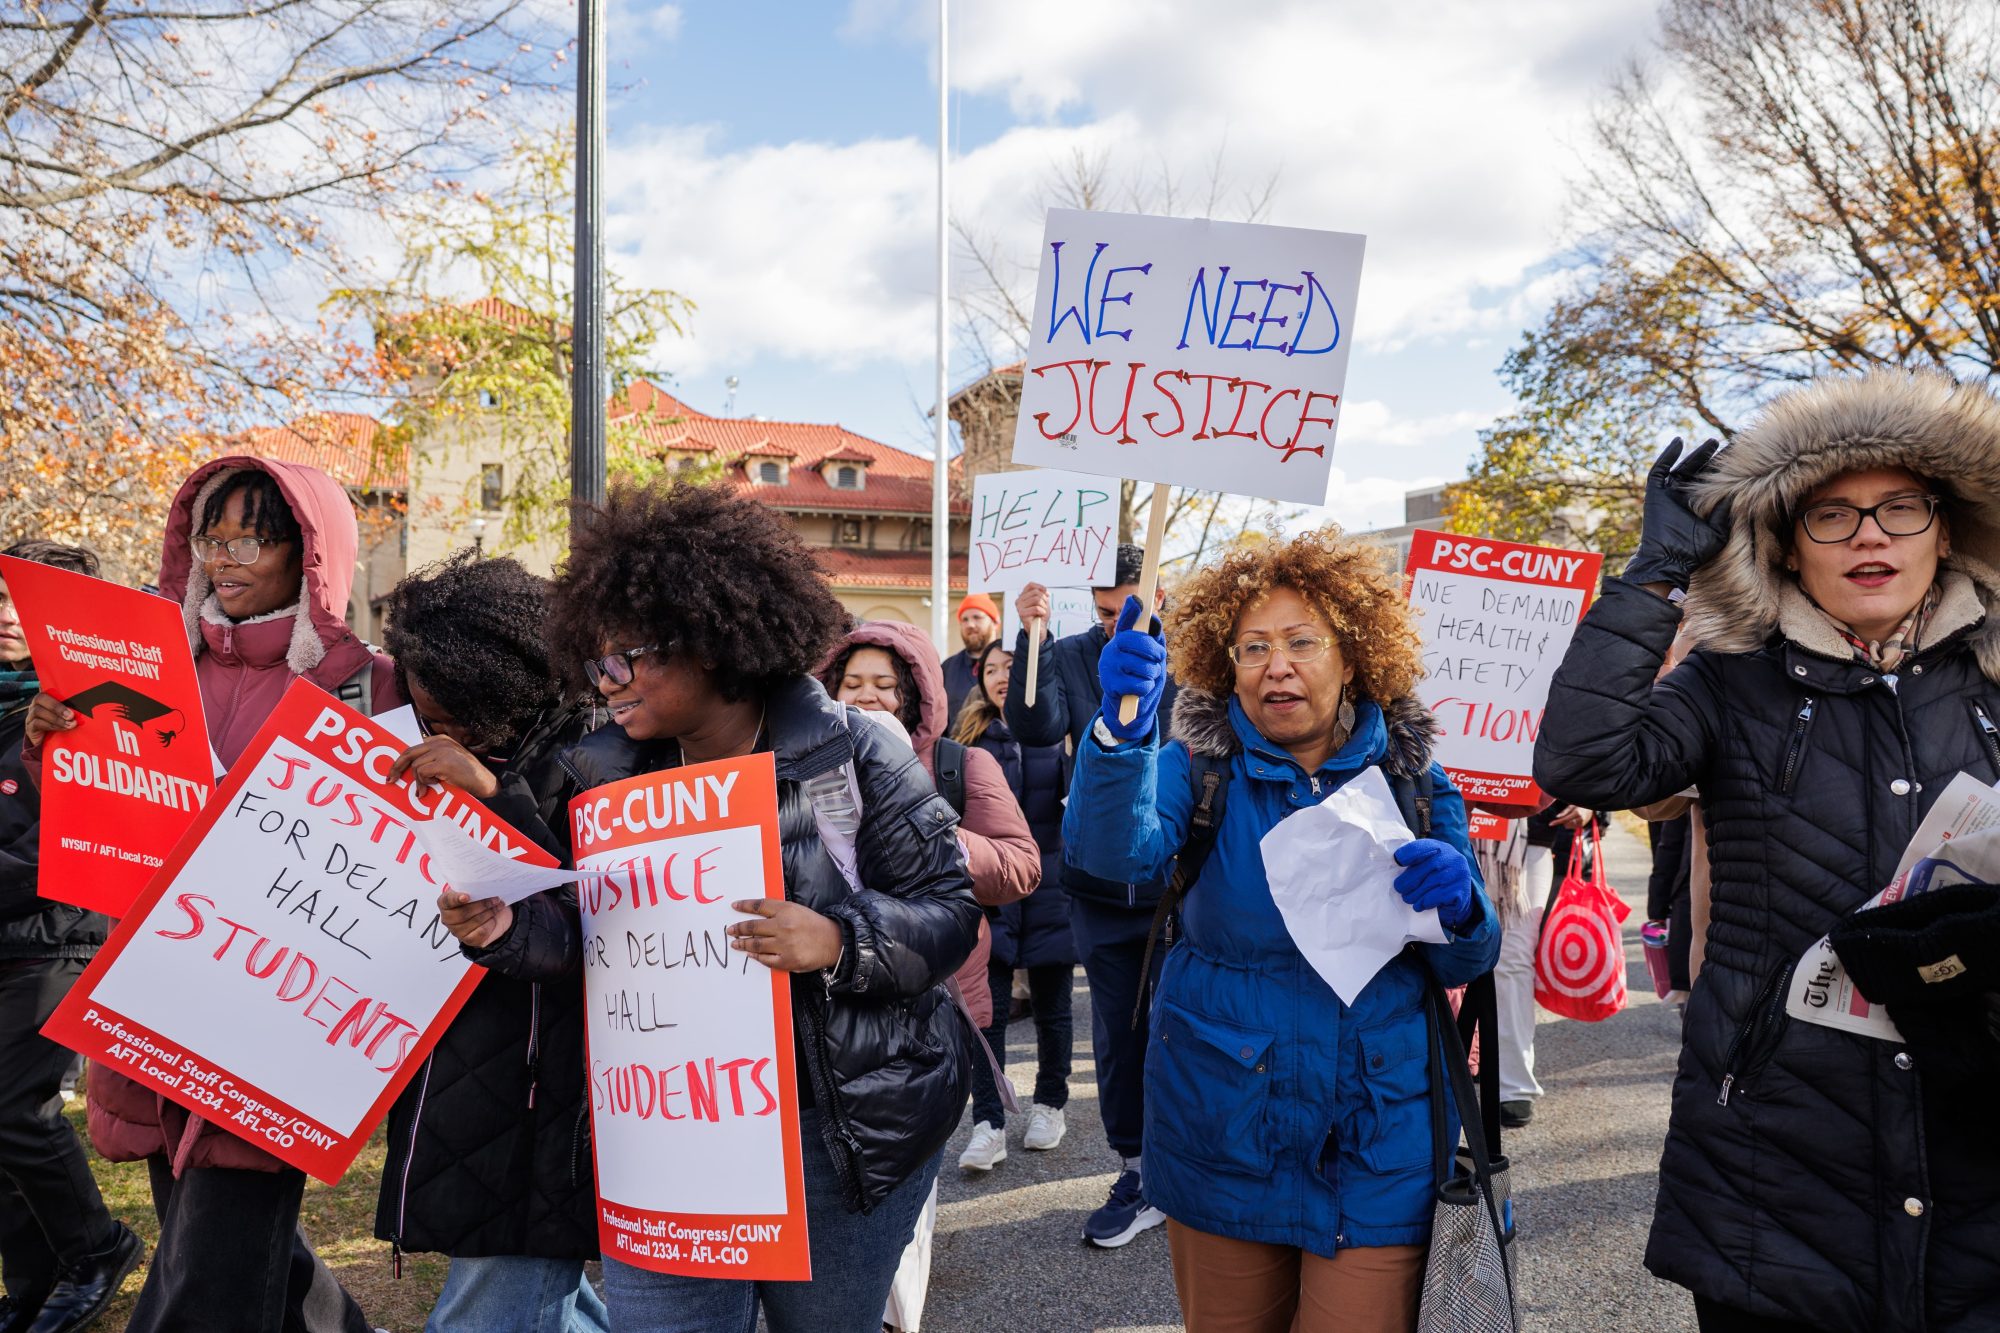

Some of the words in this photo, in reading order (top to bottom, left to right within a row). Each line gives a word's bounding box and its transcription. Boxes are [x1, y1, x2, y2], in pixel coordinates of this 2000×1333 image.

[1047, 241, 1154, 345] WE
[1177, 266, 1340, 356] NEED
[1031, 358, 1339, 463] JUSTICE
[977, 489, 1110, 538] HELP
[975, 526, 1111, 582] DELANY
[1431, 540, 1584, 583] PSC-CUNY
[1420, 579, 1457, 605] WE
[1482, 587, 1575, 626] DEMAND
[46, 624, 128, 656] Professional
[129, 641, 163, 663] Staff
[1437, 613, 1532, 652] HEALTH
[60, 644, 160, 680] Congress/CUNY
[112, 721, 140, 757] In
[52, 748, 208, 812] SOLIDARITY
[1457, 773, 1531, 788] Congress/CUNY
[1470, 786, 1508, 797] AFL-CIO
[234, 791, 311, 861] FOR
[575, 771, 740, 848] PSC-CUNY
[61, 837, 91, 853] NYSUT
[100, 845, 116, 858] AFT
[118, 849, 141, 864] Local
[577, 847, 724, 916] JUSTICE
[266, 867, 371, 960] HALL
[626, 925, 749, 975] DELAN
[155, 893, 423, 1074] STUDENTS
[1803, 961, 1837, 1008] The
[605, 989, 677, 1033] HALL
[82, 1009, 182, 1066] Professional
[180, 1059, 221, 1087] Staff
[219, 1080, 338, 1151] Congress/CUNY
[106, 1042, 142, 1065] AFT
[139, 1058, 184, 1088] Local
[180, 1081, 224, 1110] 2334
[231, 1109, 295, 1149] AFL-CIO
[592, 1057, 777, 1123] STUDENTS
[603, 1208, 642, 1234] Professional
[643, 1218, 666, 1237] Staff
[668, 1222, 782, 1244] Congress/CUNY
[616, 1233, 629, 1250] AFT
[629, 1237, 650, 1257] Local
[652, 1241, 680, 1261] 2334
[690, 1246, 748, 1265] AFL-CIO
